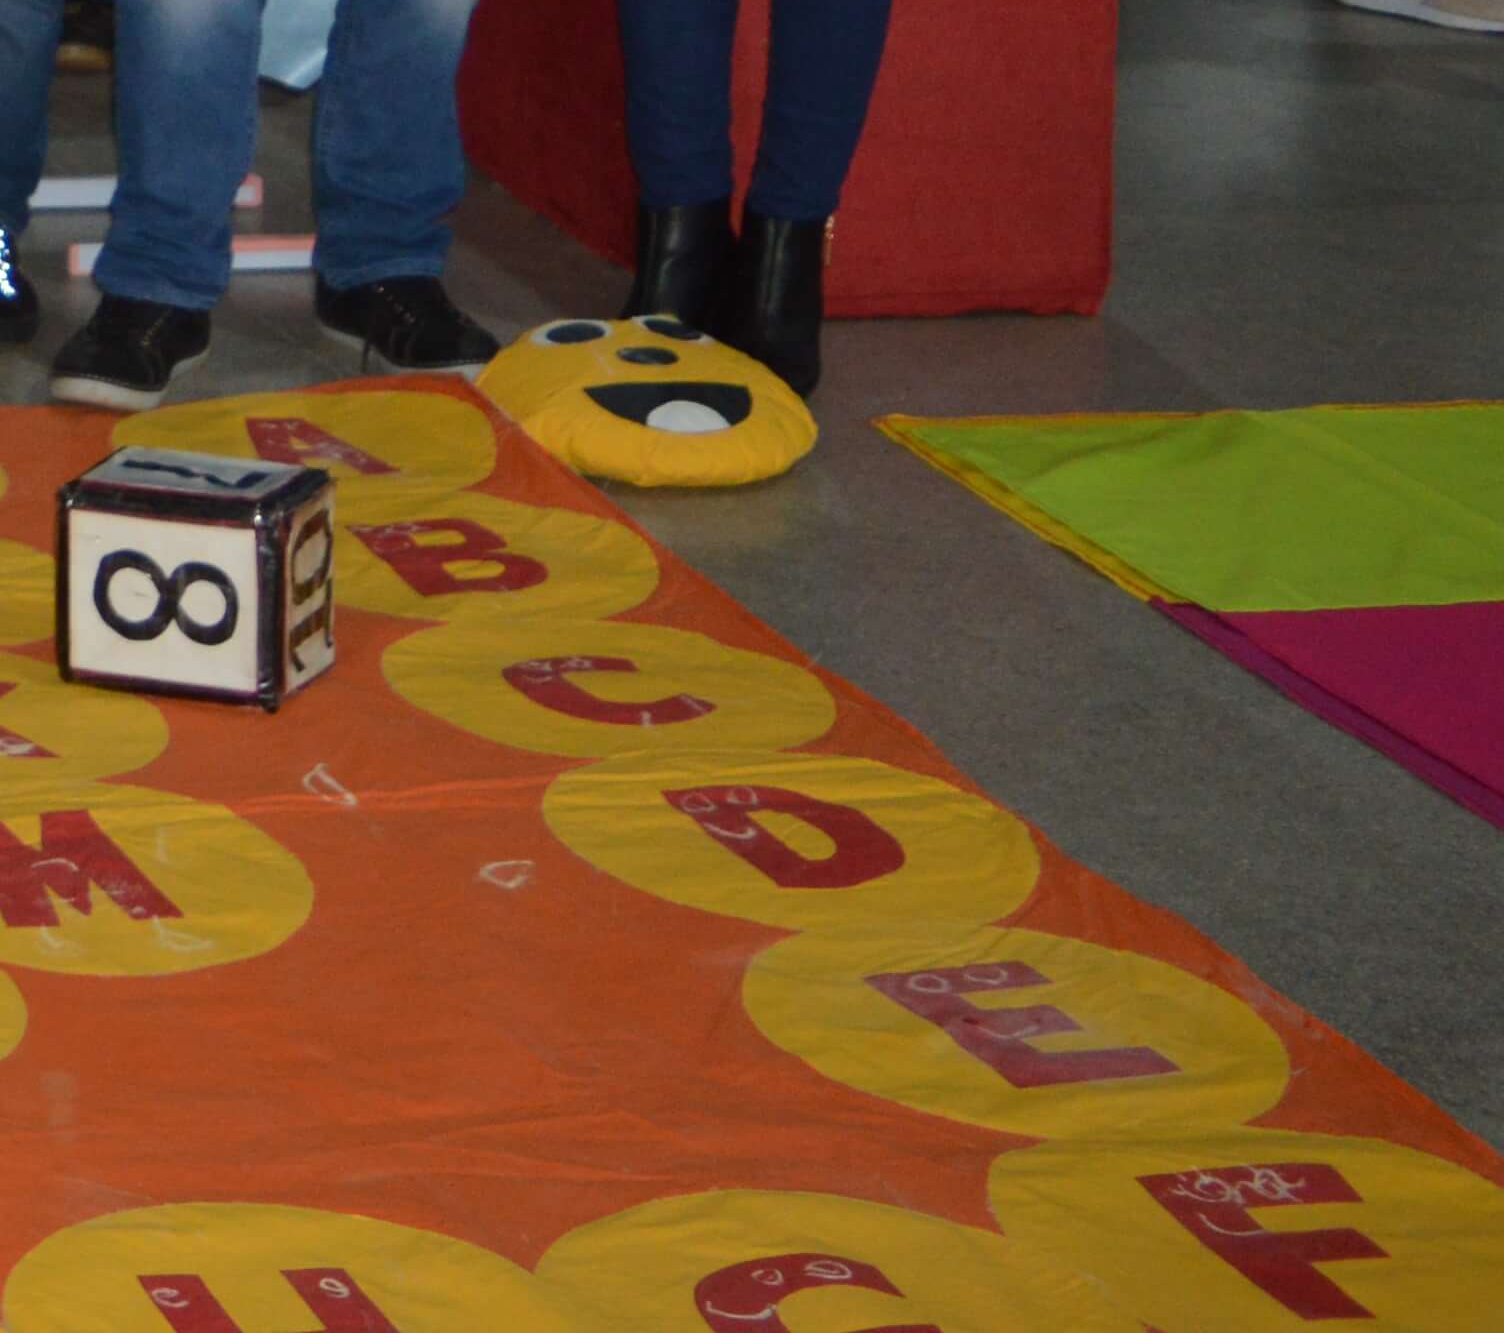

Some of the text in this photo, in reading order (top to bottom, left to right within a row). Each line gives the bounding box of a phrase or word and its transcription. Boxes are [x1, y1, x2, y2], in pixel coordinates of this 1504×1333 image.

[93, 548, 239, 645] 8
[345, 518, 549, 596] B
[503, 656, 717, 726] C
[661, 784, 906, 889] D
[863, 961, 1182, 1089] E
[1135, 1163, 1389, 1320] F
